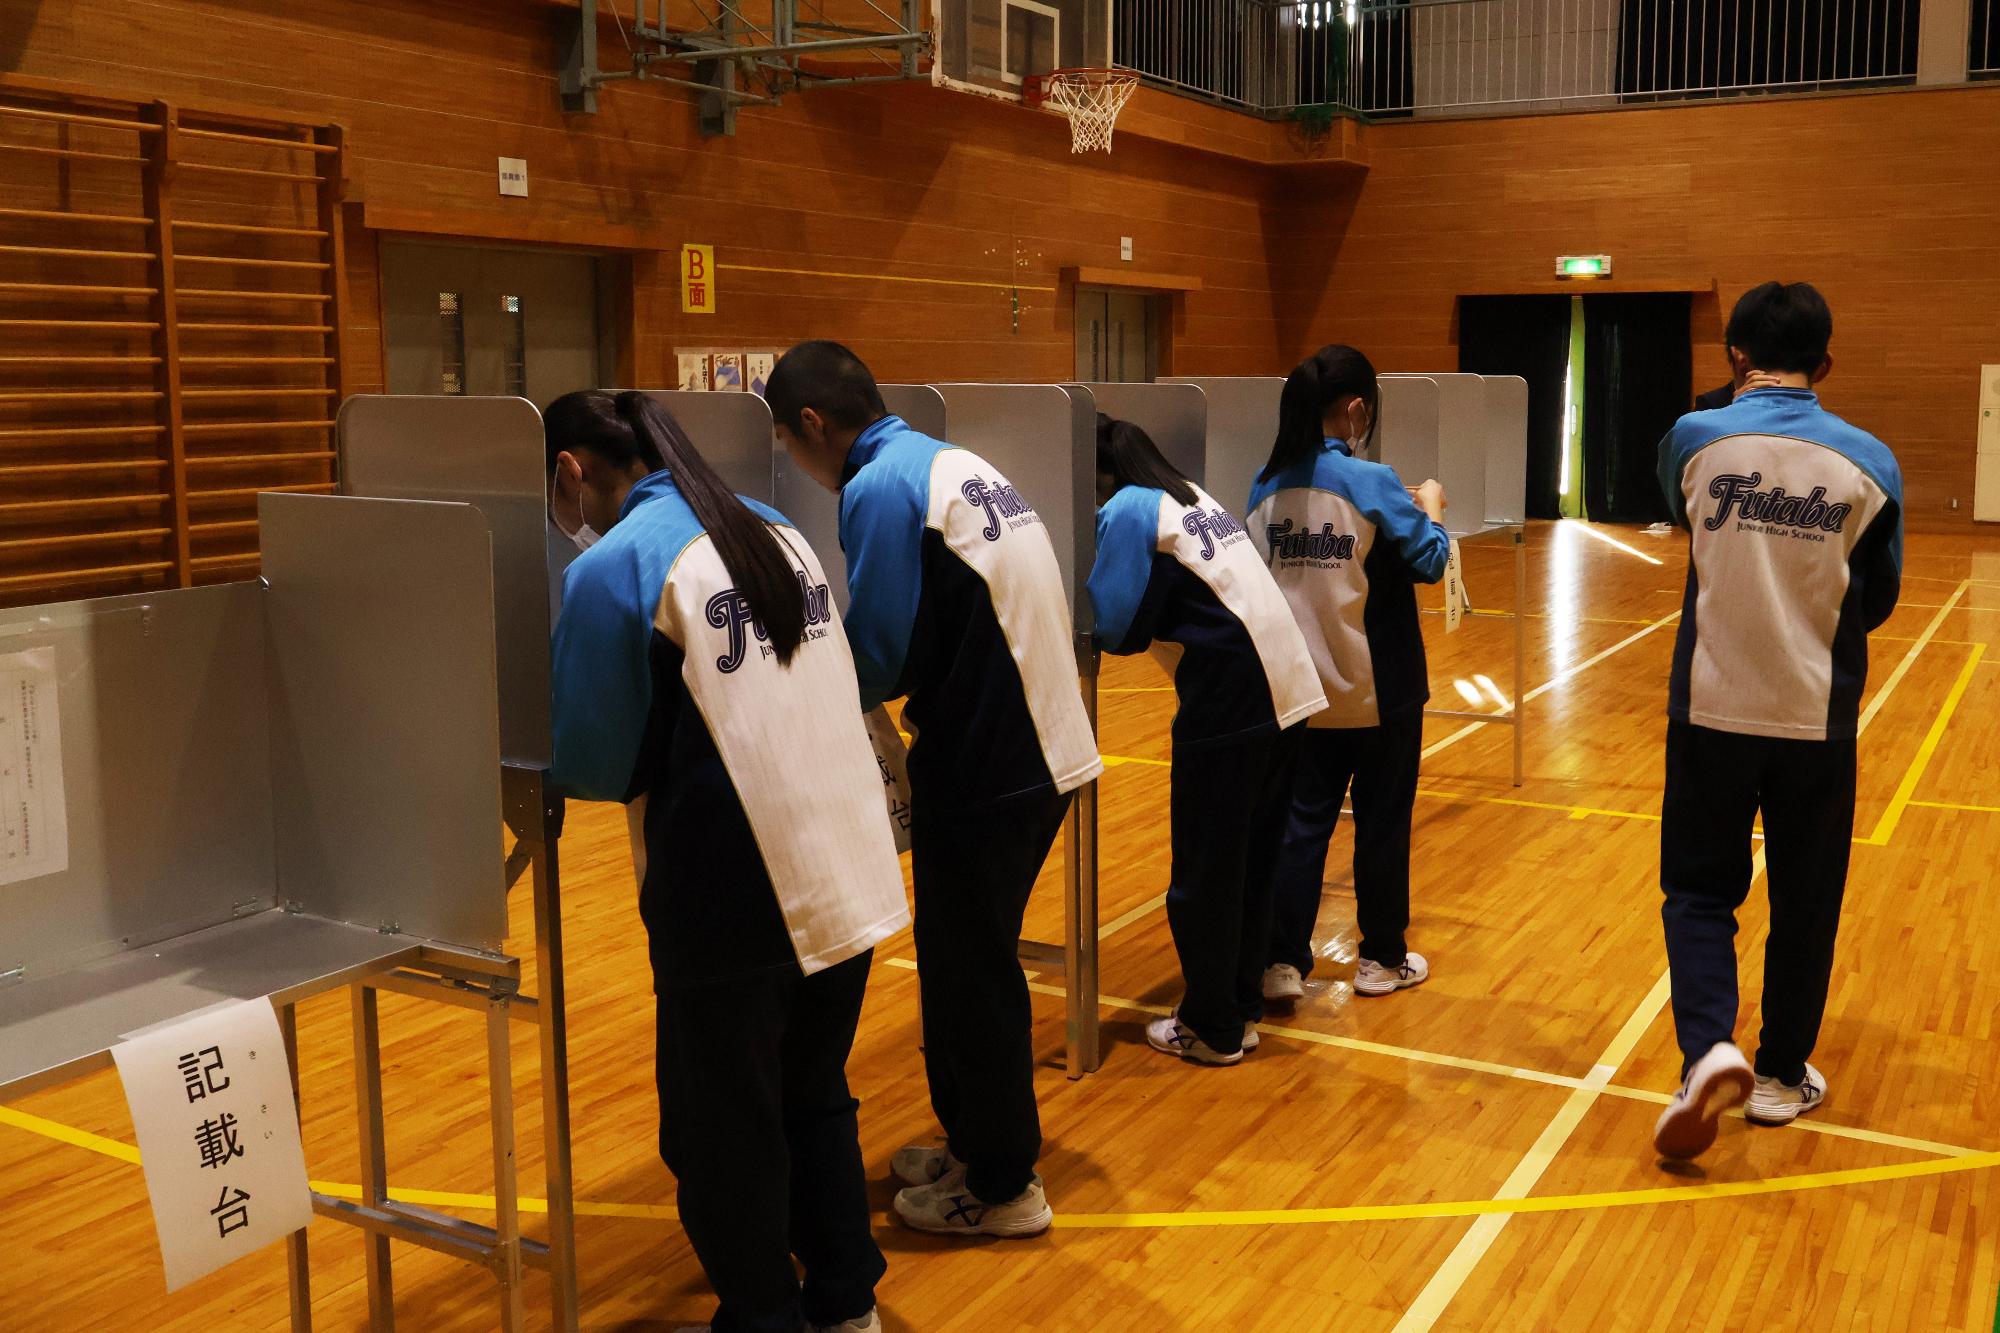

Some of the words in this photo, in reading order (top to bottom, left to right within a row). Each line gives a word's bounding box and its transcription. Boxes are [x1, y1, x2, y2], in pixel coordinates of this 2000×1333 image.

[1704, 471, 1852, 532] Futaba
[1266, 518, 1356, 570] Futaba
[1765, 526, 1788, 537] HIGH
[1791, 528, 1824, 543] SCHOOL
[178, 1045, 251, 1239] 記載台
